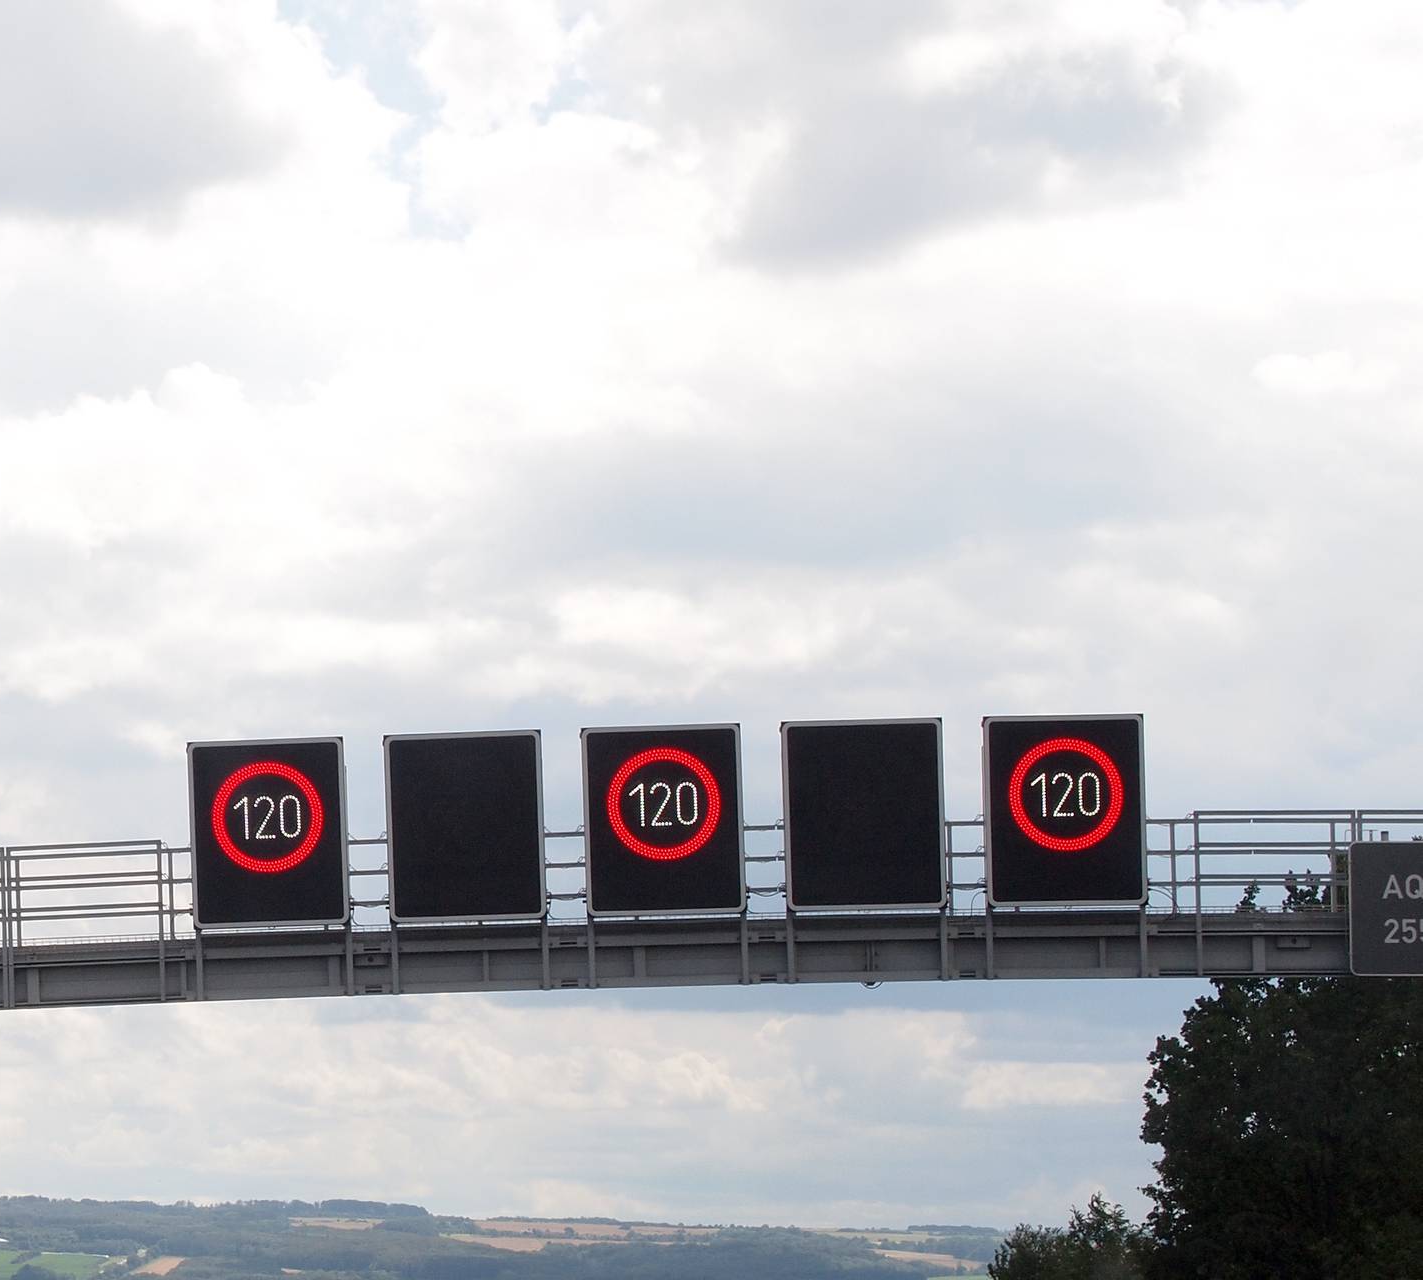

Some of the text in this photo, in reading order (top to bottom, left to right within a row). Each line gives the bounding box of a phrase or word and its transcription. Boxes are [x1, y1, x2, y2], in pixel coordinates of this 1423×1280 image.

[233, 794, 301, 840] 120
[628, 782, 698, 827] 120
[1030, 772, 1100, 817] 120
[1382, 874, 1423, 899] AQ
[1384, 919, 1423, 944] 25
